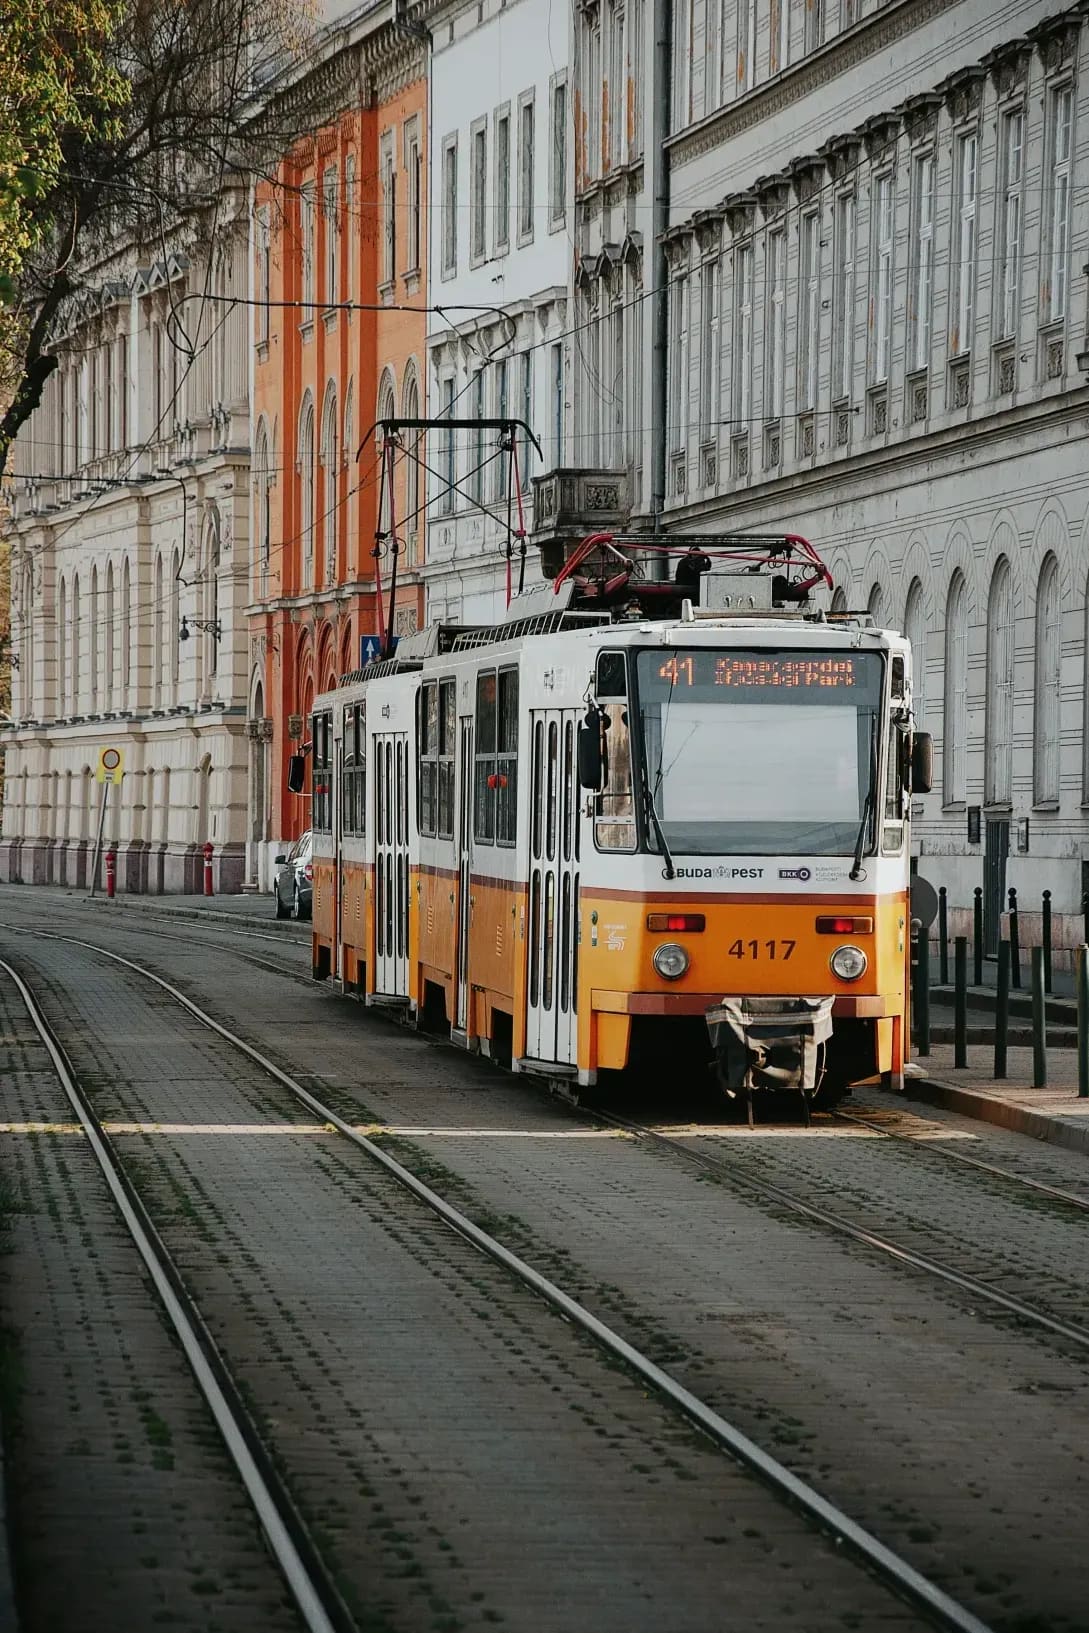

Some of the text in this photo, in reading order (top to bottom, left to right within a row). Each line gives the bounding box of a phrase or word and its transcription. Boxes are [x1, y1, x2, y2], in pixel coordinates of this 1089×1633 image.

[659, 656, 695, 686] 41
[805, 672, 856, 686] Park
[728, 939, 796, 960] 4117
